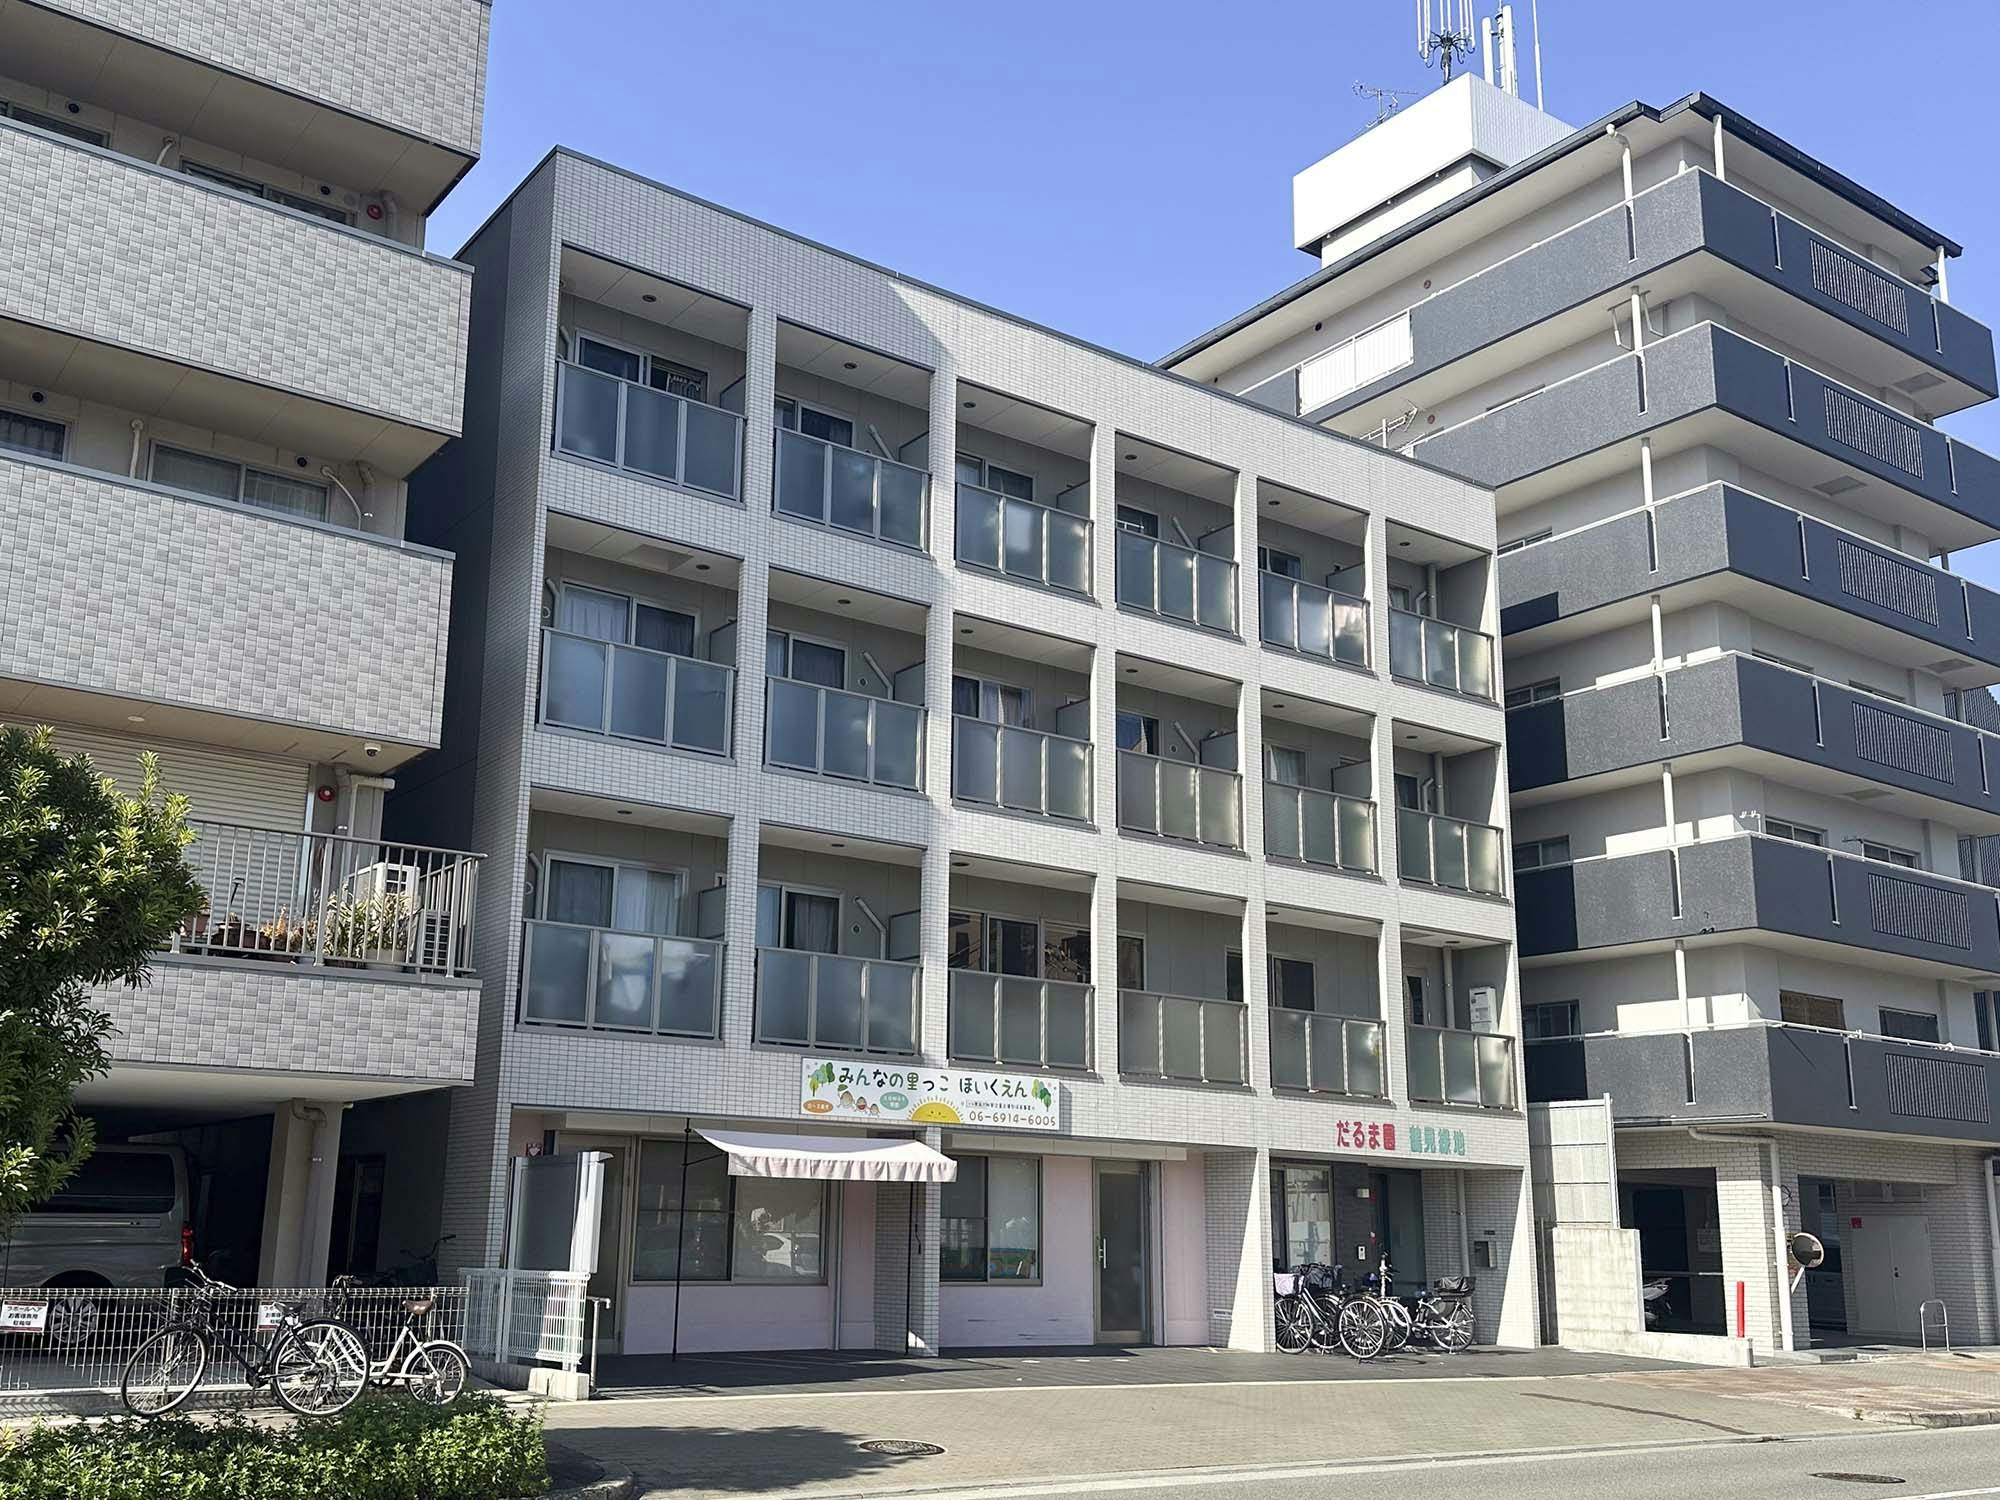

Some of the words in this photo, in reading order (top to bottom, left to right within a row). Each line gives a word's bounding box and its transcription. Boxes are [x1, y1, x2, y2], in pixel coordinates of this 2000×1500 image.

[838, 1067, 949, 1091] みんなの里っこ
[959, 1077, 1028, 1098] ほいくえん
[969, 1111, 1056, 1126] 06-6914-6005
